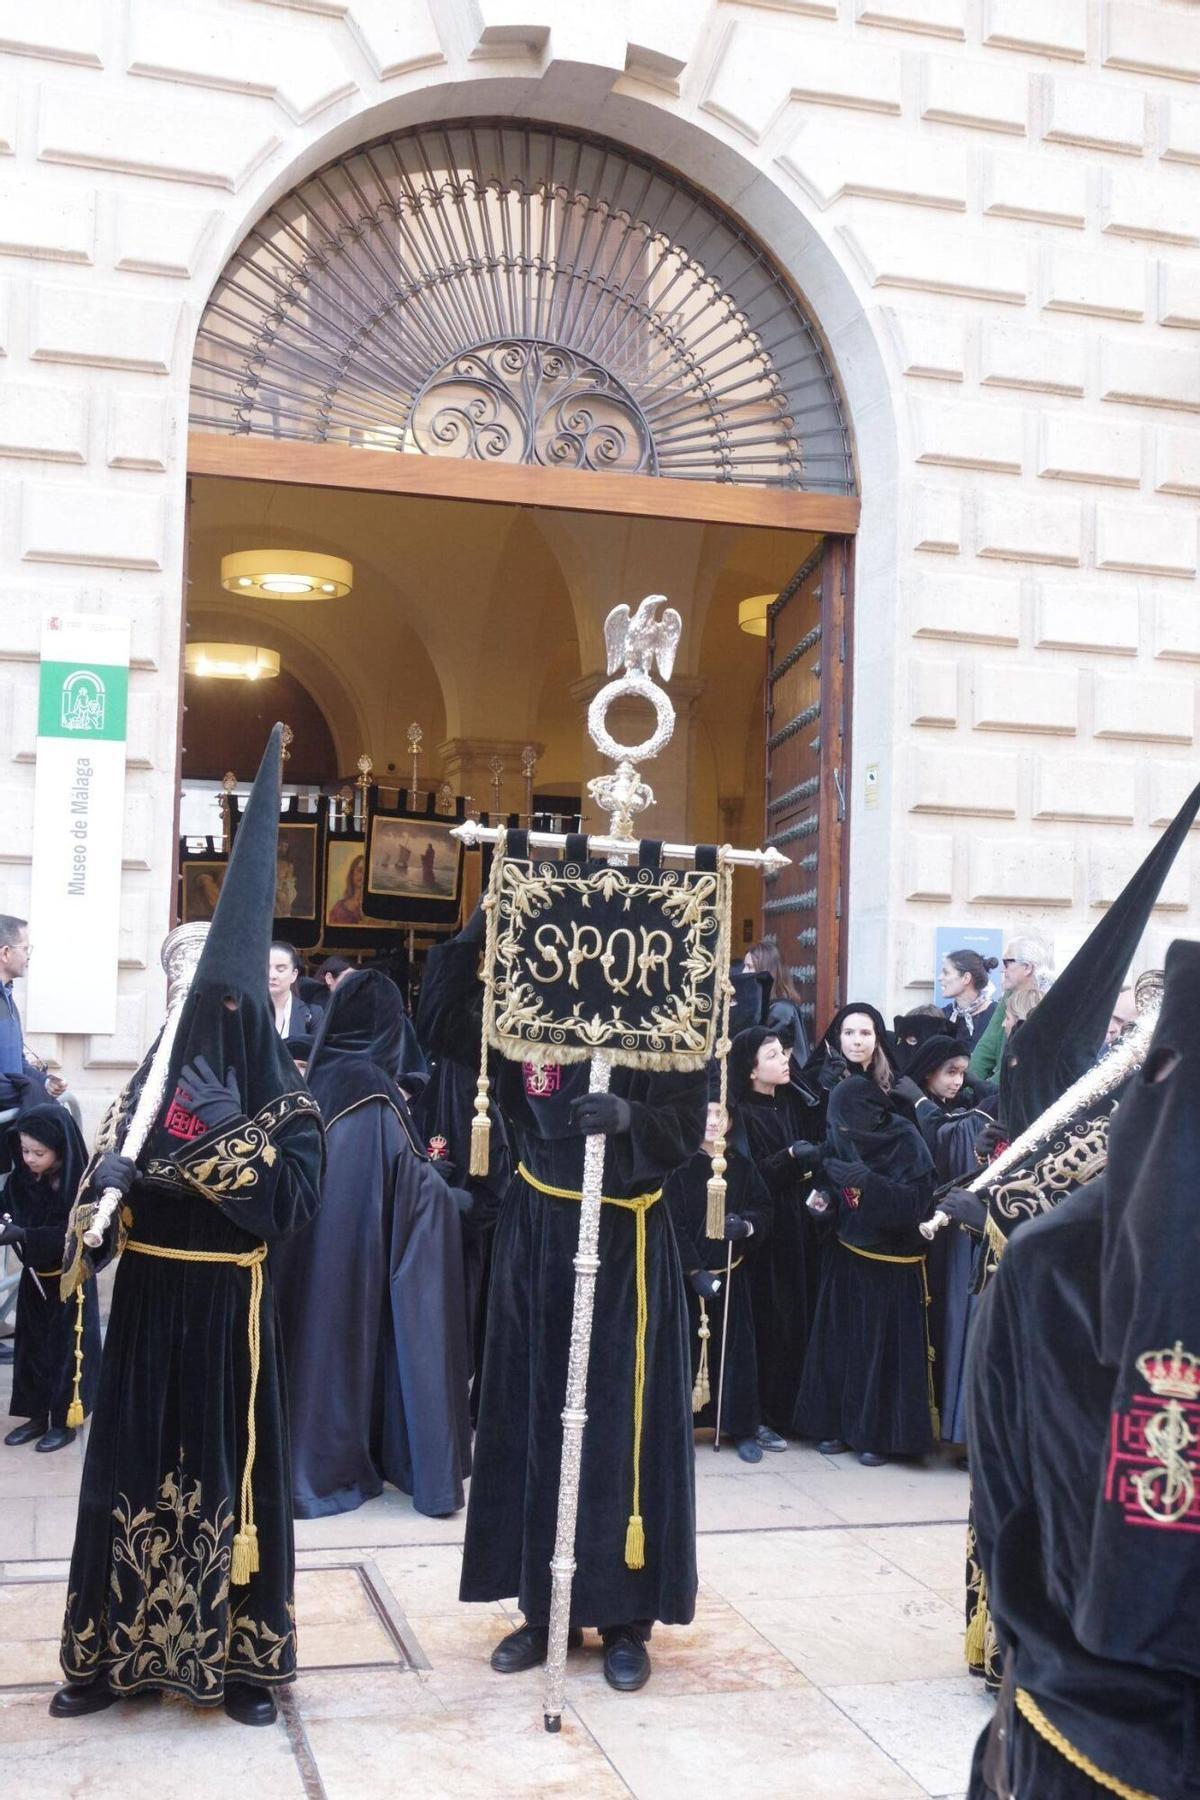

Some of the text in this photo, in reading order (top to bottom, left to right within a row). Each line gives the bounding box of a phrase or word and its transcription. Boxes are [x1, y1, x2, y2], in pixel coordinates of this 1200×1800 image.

[67, 757, 94, 896] Museo de Málaga
[525, 920, 673, 996] SPQR
